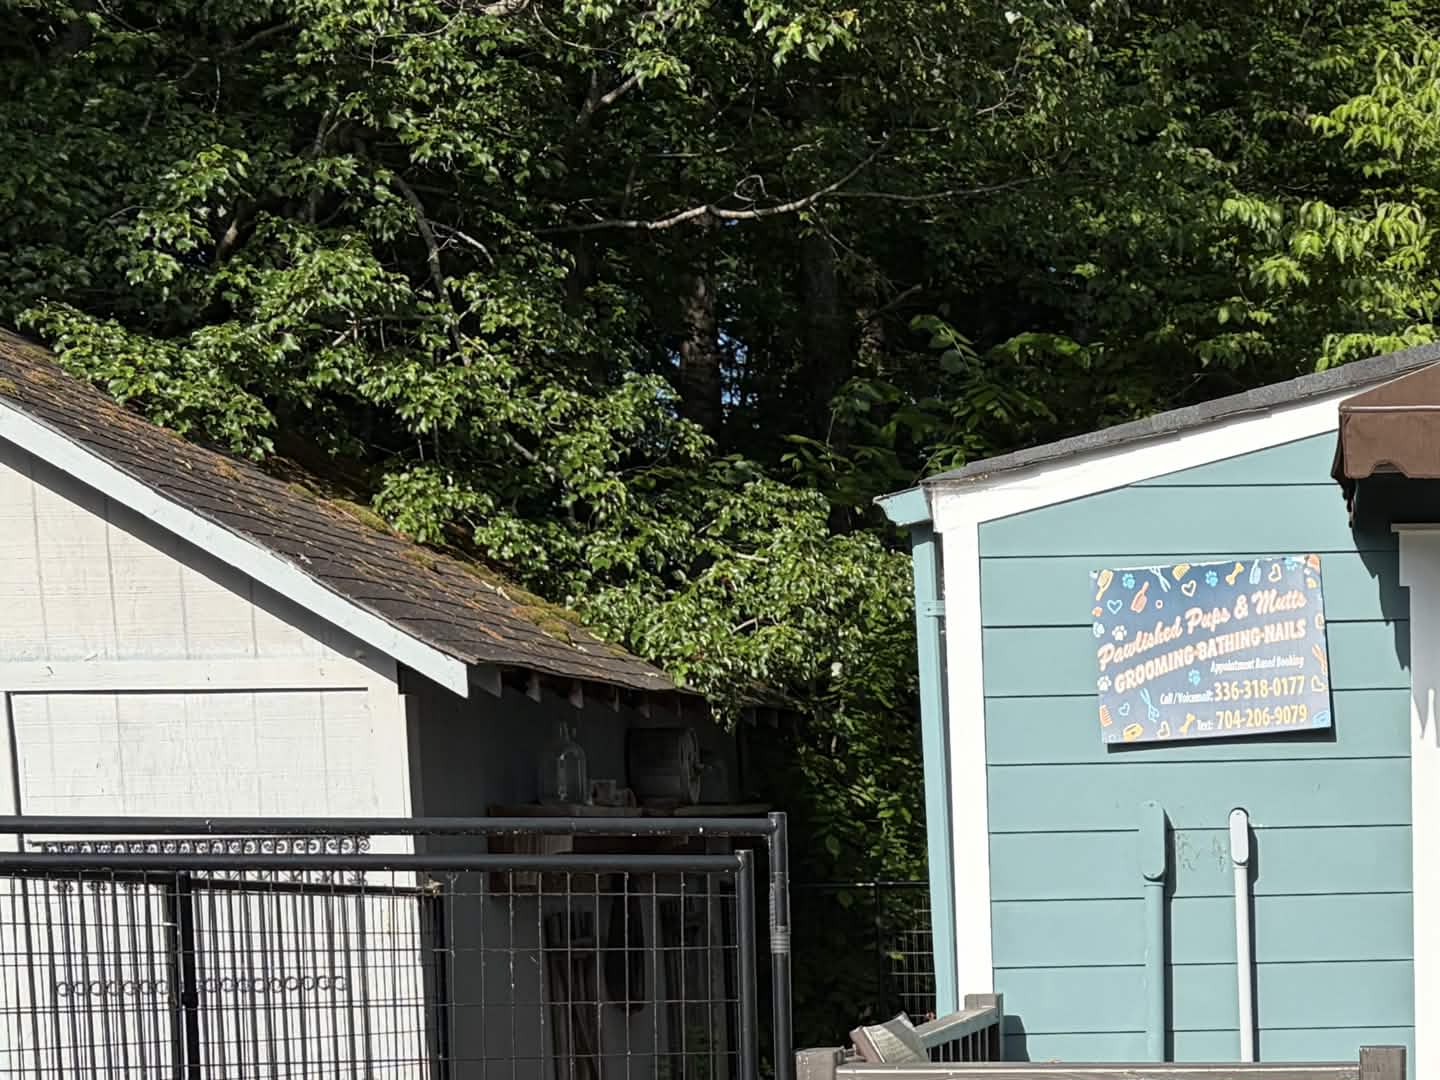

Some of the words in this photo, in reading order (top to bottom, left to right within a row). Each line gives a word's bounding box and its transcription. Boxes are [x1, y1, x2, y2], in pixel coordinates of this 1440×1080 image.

[1097, 615, 1183, 672] Pawlished
[1185, 607, 1231, 635] Pups
[1233, 594, 1249, 619] &
[1251, 588, 1308, 615] Mutts
[1214, 675, 1305, 702] 336-318-0177
[1215, 704, 1308, 730] 704-206-9079
